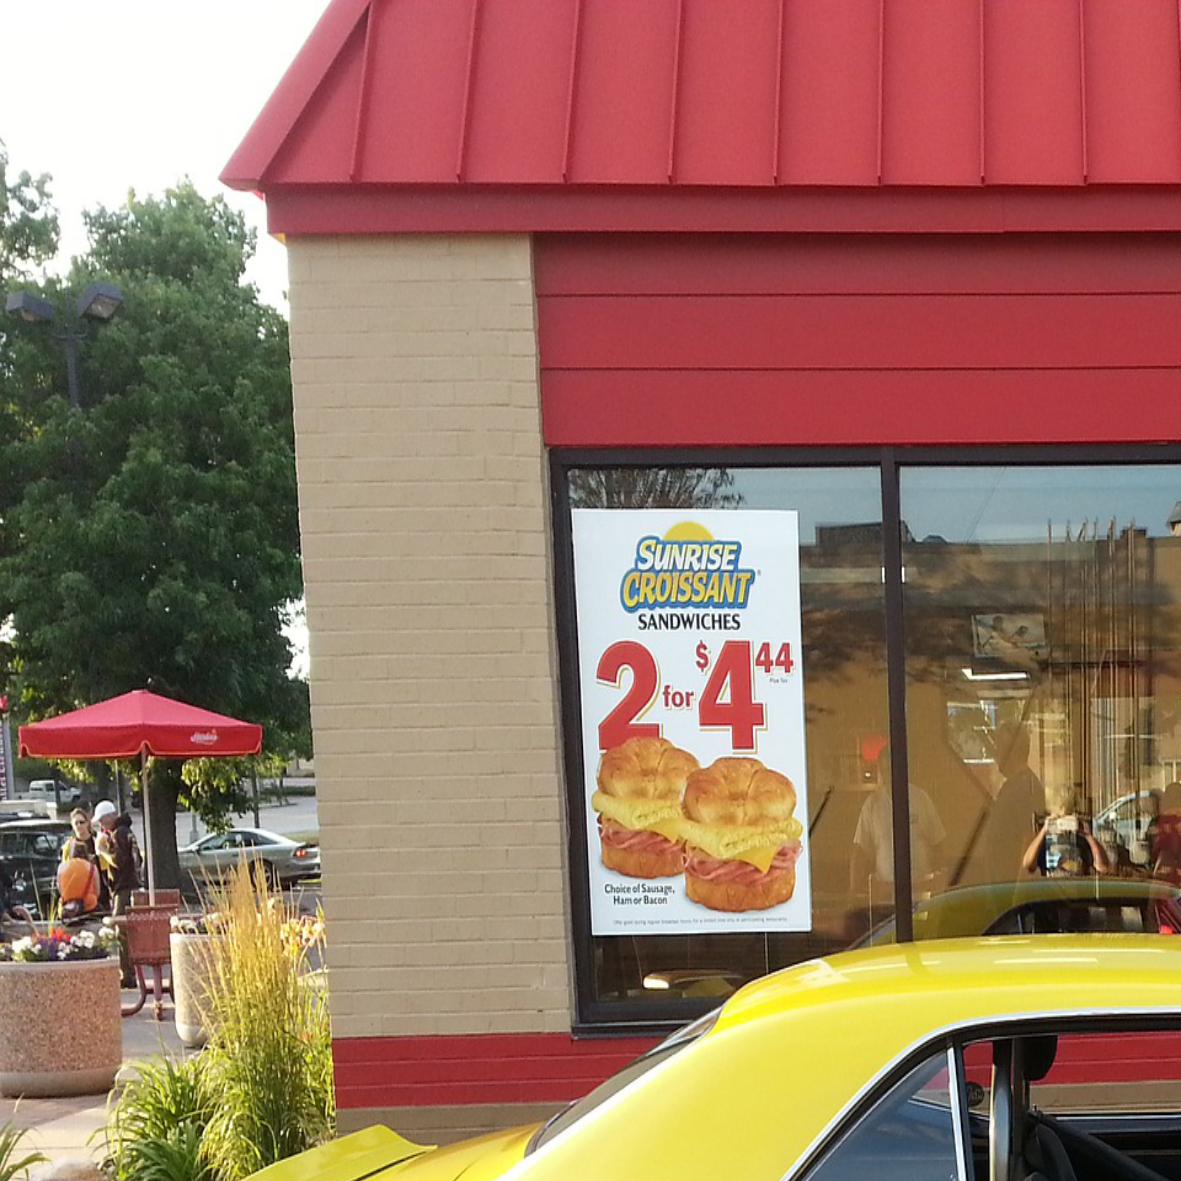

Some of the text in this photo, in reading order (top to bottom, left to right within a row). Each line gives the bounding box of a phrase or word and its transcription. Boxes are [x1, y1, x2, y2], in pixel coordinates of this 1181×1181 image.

[637, 539, 738, 572] SUNRISE
[623, 571, 751, 608] CROISSANT
[638, 613, 741, 631] SANDWICHES
[596, 640, 660, 750] 2
[662, 685, 694, 708] for
[604, 883, 631, 894] Choice
[632, 883, 640, 894] of
[613, 895, 668, 906] Ham or Bacon
